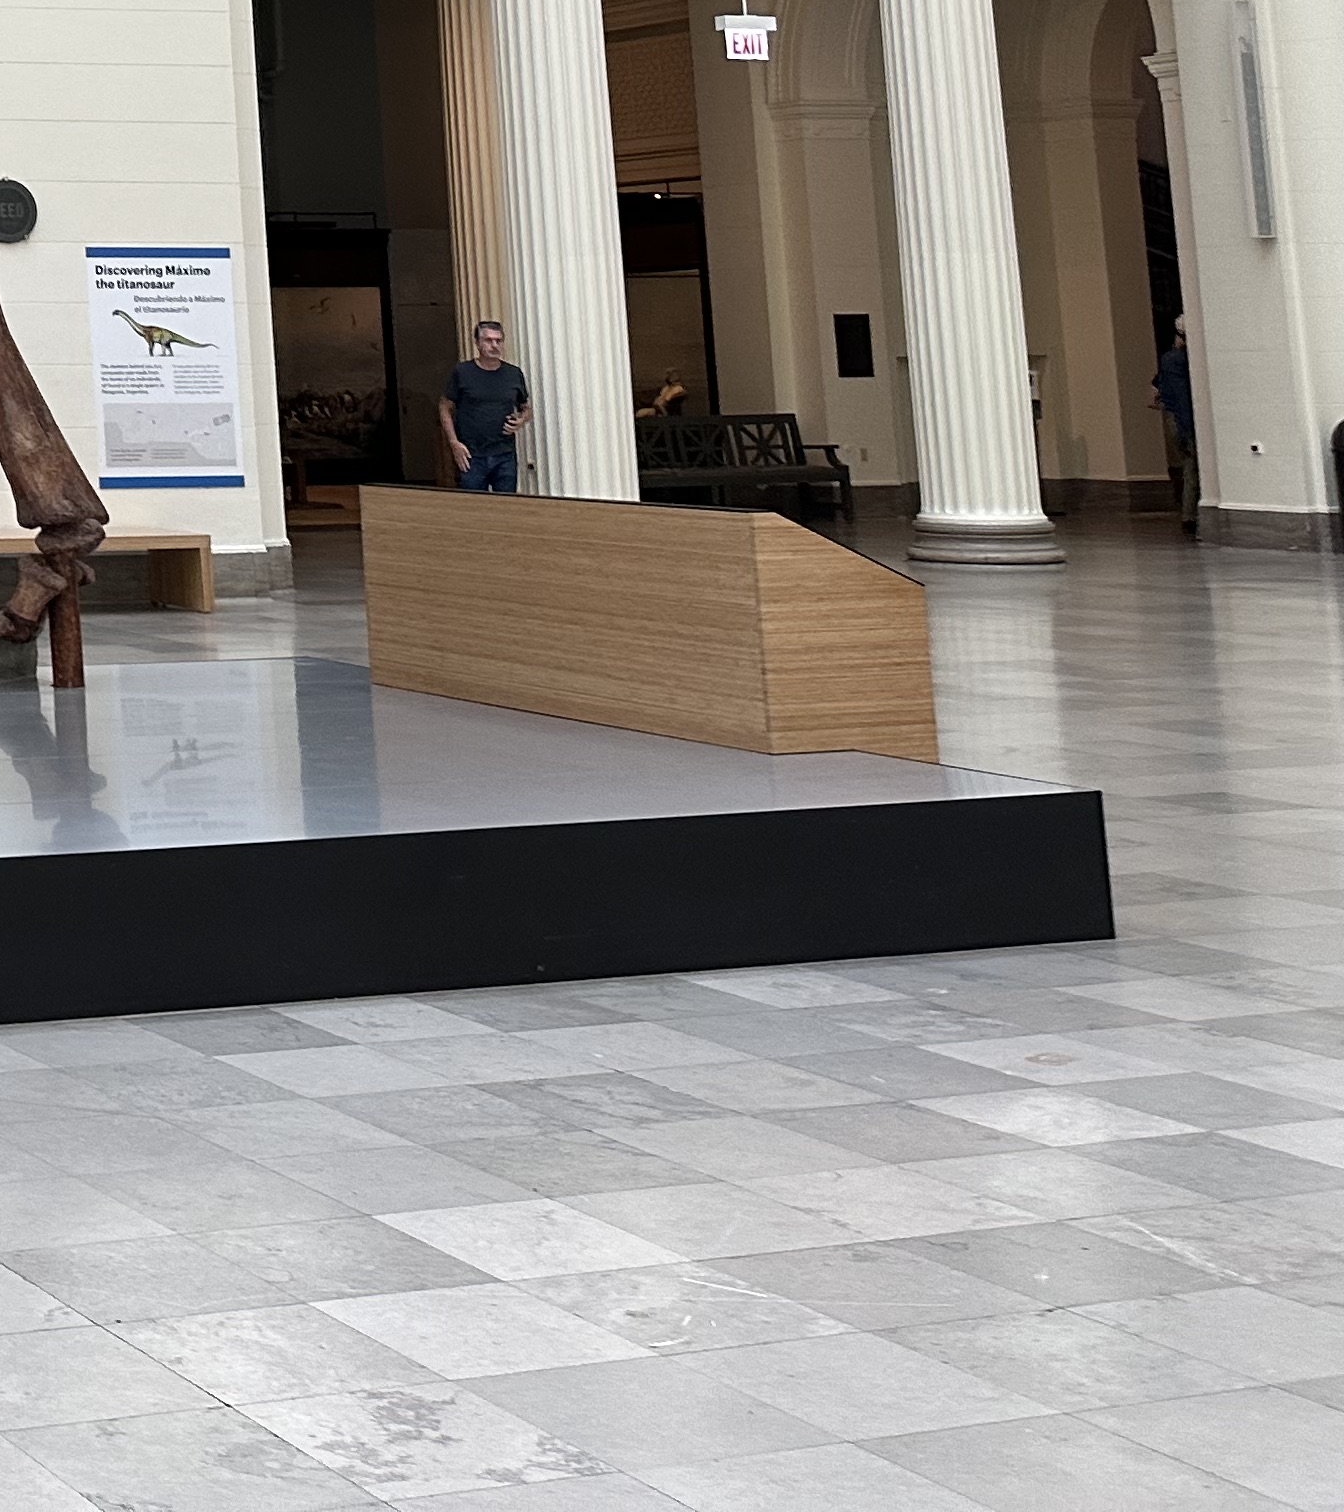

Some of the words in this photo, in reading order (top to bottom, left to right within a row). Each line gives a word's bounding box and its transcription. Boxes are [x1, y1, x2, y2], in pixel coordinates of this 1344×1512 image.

[732, 32, 762, 55] EXIT
[95, 264, 163, 277] Discovering
[165, 264, 211, 276] Máximo
[95, 278, 115, 289] the
[117, 278, 175, 289] titanosaur
